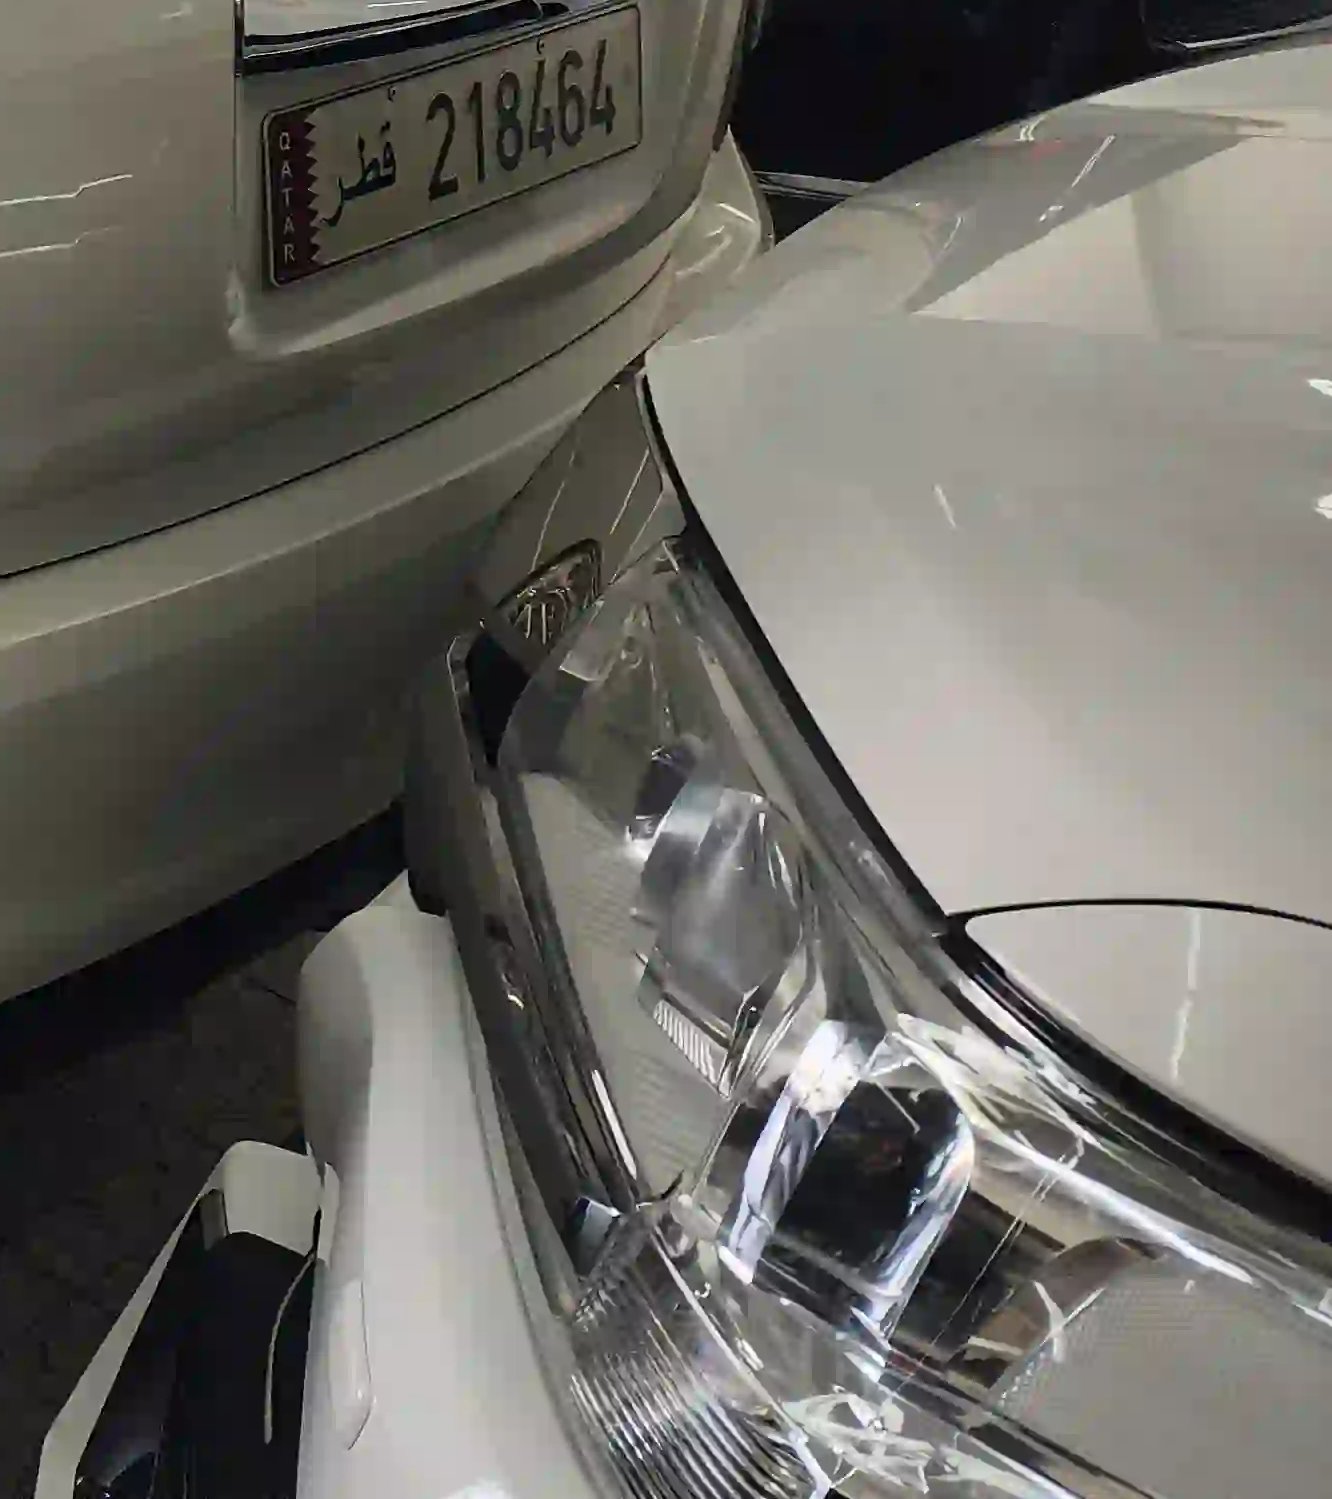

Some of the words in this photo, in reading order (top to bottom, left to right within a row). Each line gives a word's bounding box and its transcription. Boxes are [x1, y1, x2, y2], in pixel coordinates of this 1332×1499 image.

[319, 121, 397, 228] قطر
[425, 38, 616, 202] 218464
[278, 131, 296, 263] QATAR
